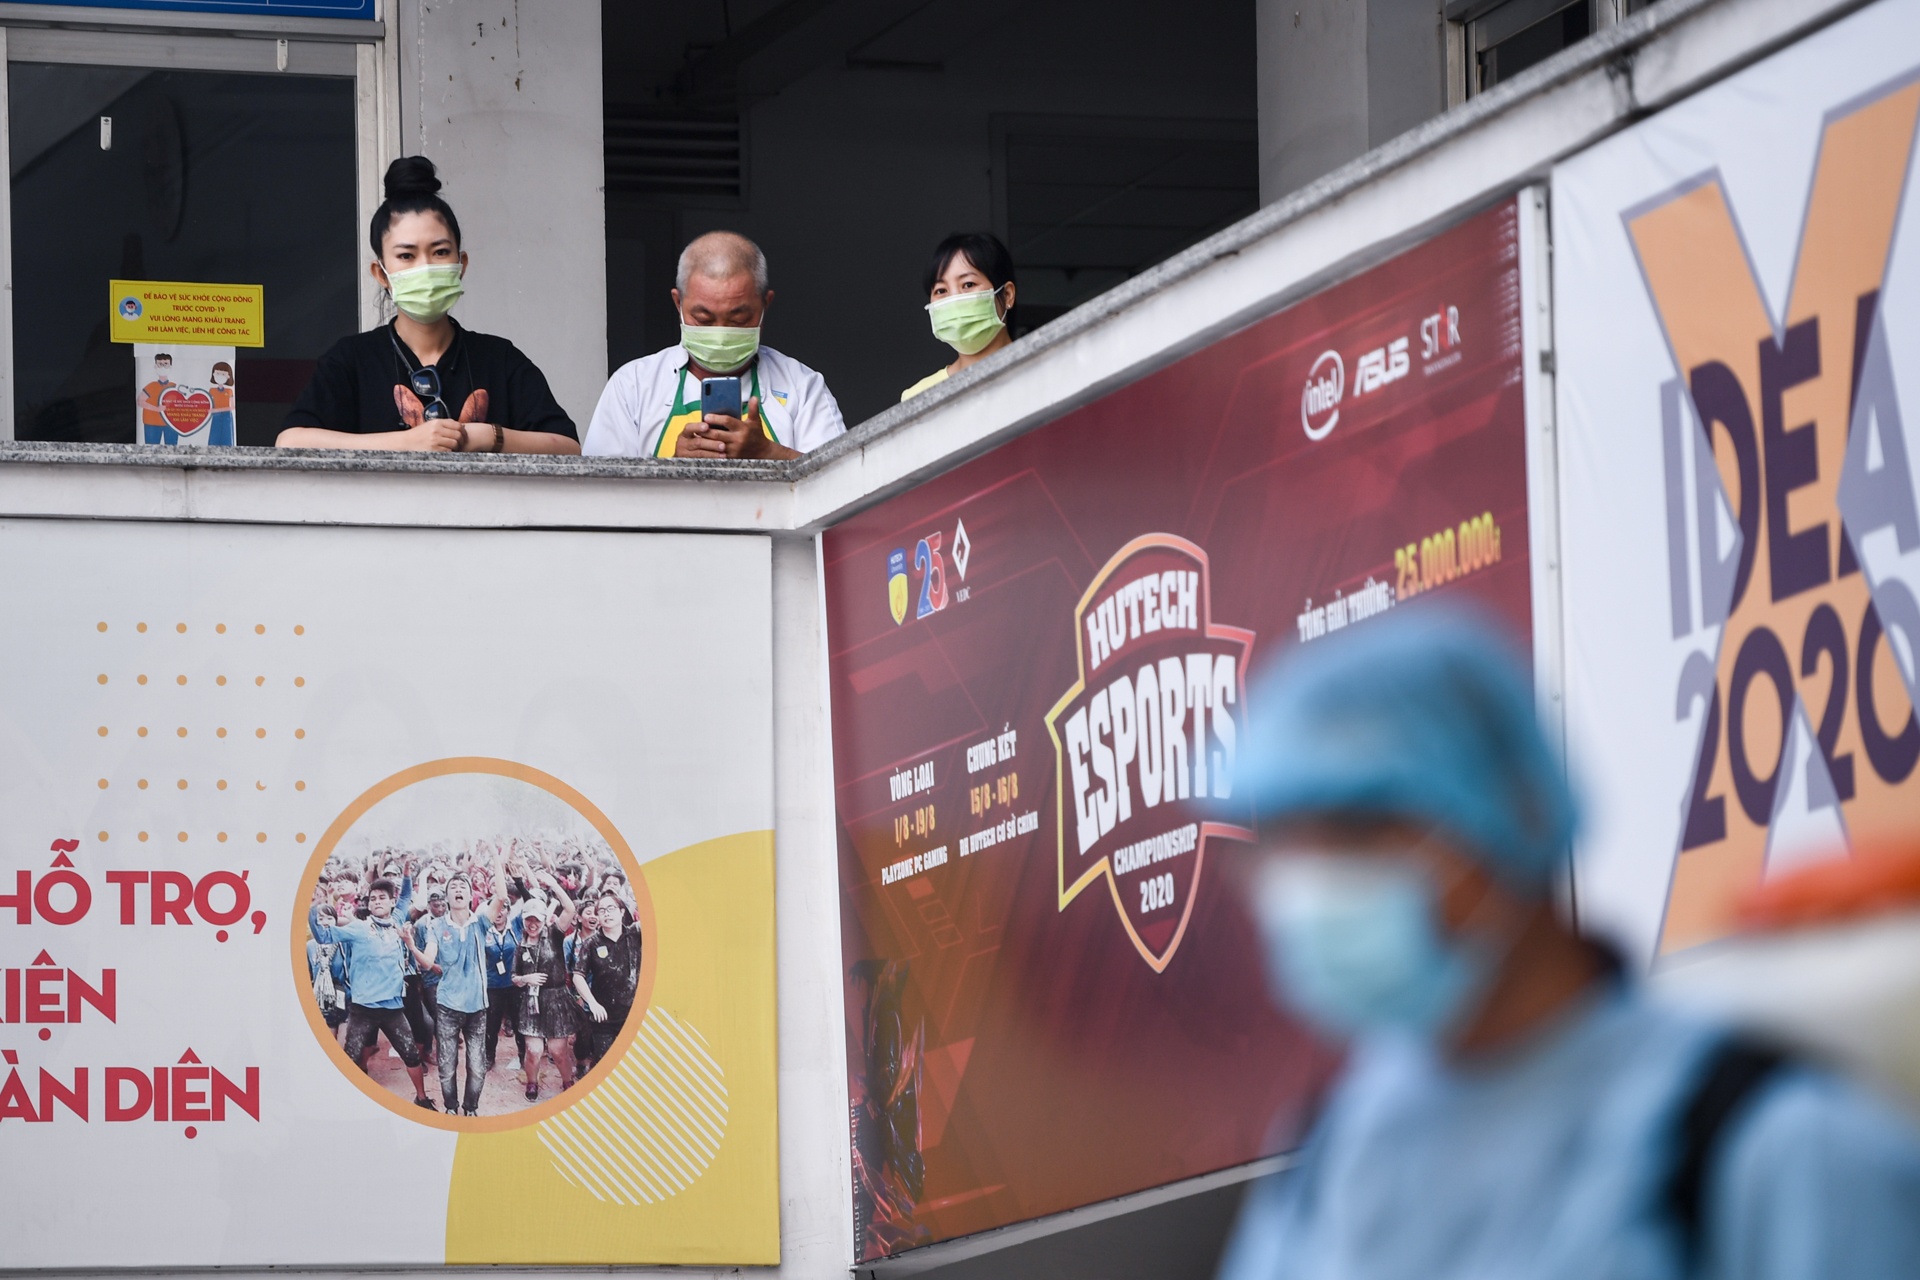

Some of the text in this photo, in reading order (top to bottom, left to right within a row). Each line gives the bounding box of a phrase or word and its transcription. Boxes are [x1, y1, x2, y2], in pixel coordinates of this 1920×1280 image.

[195, 305, 225, 313] COVID-19
[224, 317, 246, 325] TRANG
[1306, 366, 1339, 416] intel
[1353, 335, 1410, 398] ASUS
[1659, 286, 1920, 641] IDEA
[1086, 569, 1199, 671] HUTECH
[1675, 575, 1920, 853] 2020
[966, 721, 1017, 774] CHUNG KẾT
[1064, 652, 1237, 856] ESPORTS
[889, 760, 935, 802] VÒNG LOẠI
[881, 845, 948, 886] PLAYZONE PC GAMING
[969, 826, 997, 854] HUTECH
[1112, 822, 1199, 877] CHAMPIONSHIP
[105, 869, 267, 943] TRỢ,
[1139, 871, 1175, 915] 2020
[0, 948, 117, 1041] IỆN
[104, 1046, 260, 1140] DIỆN
[853, 1178, 859, 1195] OF
[853, 1202, 862, 1262] LEAGUE
